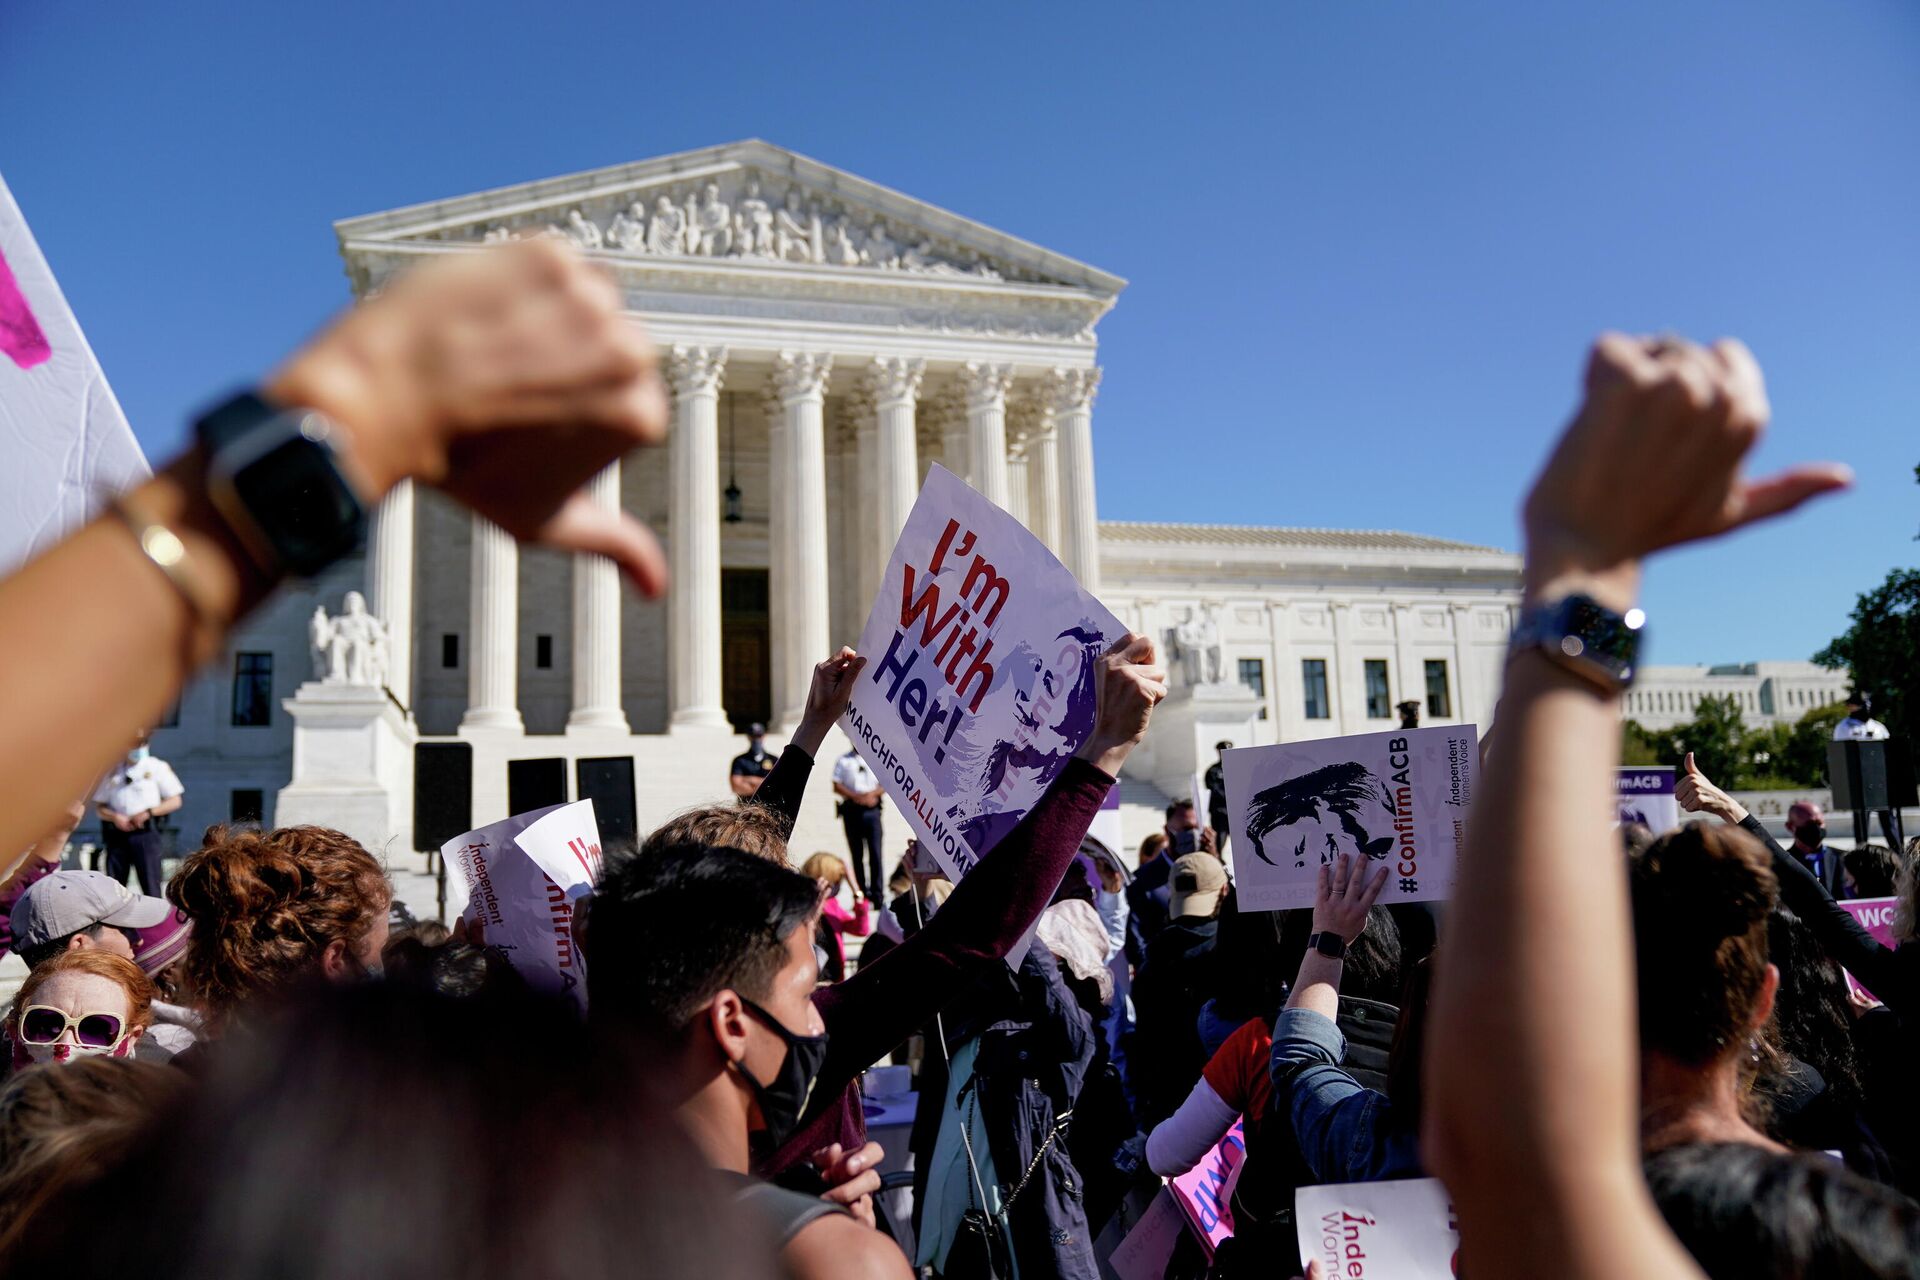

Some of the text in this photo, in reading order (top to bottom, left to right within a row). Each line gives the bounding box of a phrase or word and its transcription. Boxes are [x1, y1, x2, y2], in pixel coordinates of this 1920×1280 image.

[900, 563, 994, 715] With
[928, 517, 1010, 628] I'm
[872, 630, 964, 766] Her!
[1389, 737, 1418, 893] #ConfirmACB
